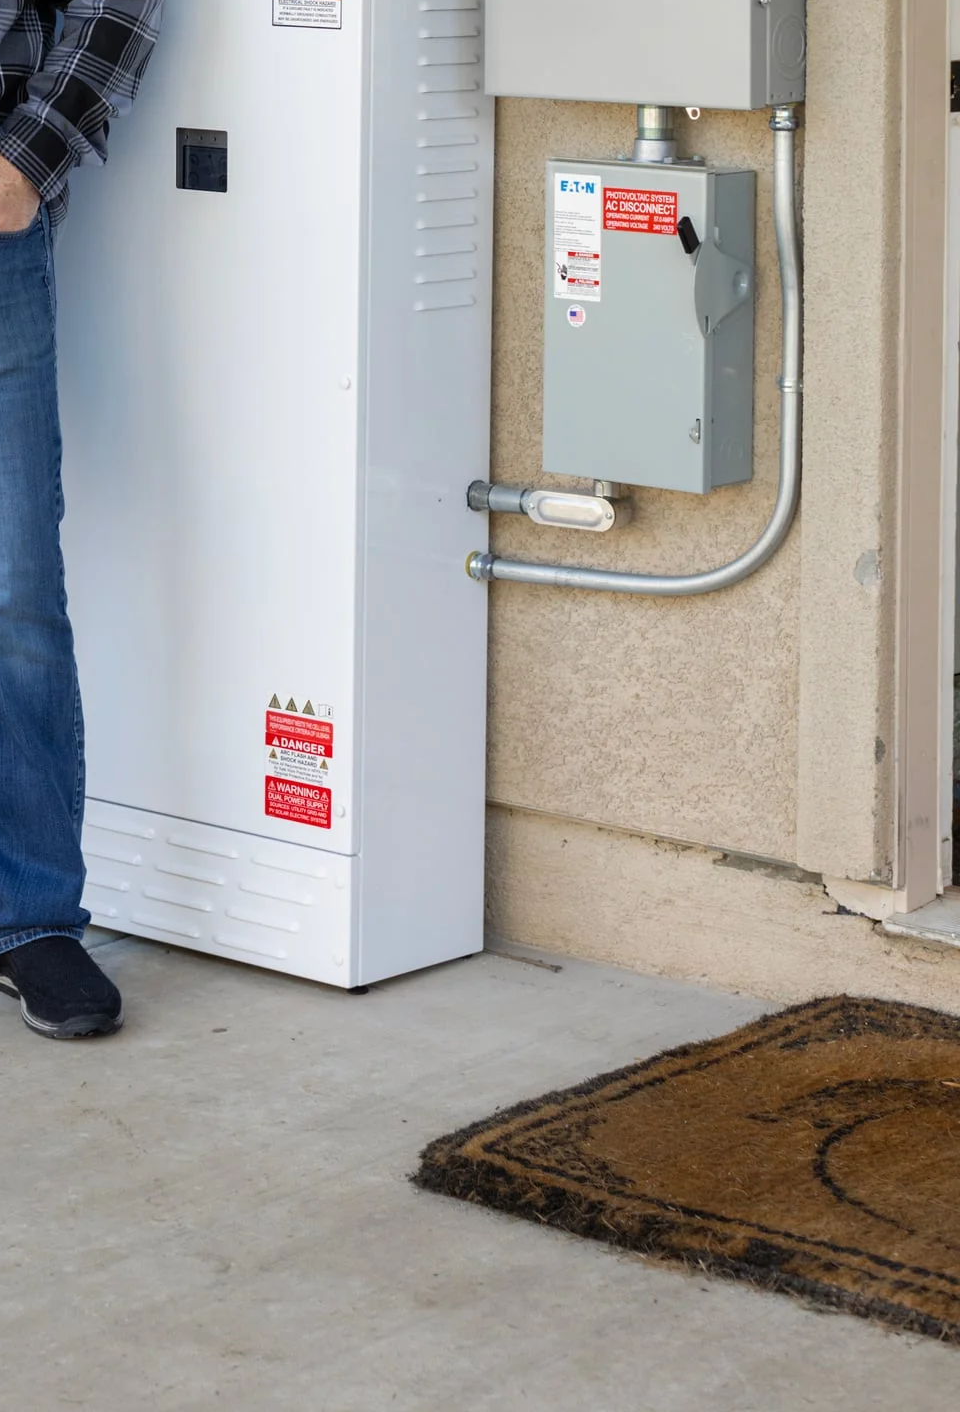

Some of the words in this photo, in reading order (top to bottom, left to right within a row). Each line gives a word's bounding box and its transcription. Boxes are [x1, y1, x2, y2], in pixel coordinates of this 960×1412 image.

[605, 190, 649, 202] PHOTOVOLTAIC
[651, 194, 675, 203] SYSTEM
[605, 200, 618, 210] AC
[620, 201, 676, 216] DISCONNECT
[605, 212, 629, 220] OPERATING
[630, 214, 649, 222] CURRENT
[605, 220, 629, 228] OPERATING
[630, 222, 648, 230] VOLTAGE
[662, 224, 674, 232] VOLTS
[281, 737, 325, 755] DANGER
[291, 751, 307, 759] FLASH
[297, 759, 318, 768] HAZARD
[276, 781, 320, 800] WARNING
[268, 792, 283, 801] DUAL
[284, 795, 305, 805] POWER
[306, 800, 328, 811] SUPPLY
[290, 806, 306, 814] UTILITY
[307, 809, 317, 817] GRID
[290, 812, 310, 820] ELECTRIC
[310, 816, 328, 825] SYSTEM
